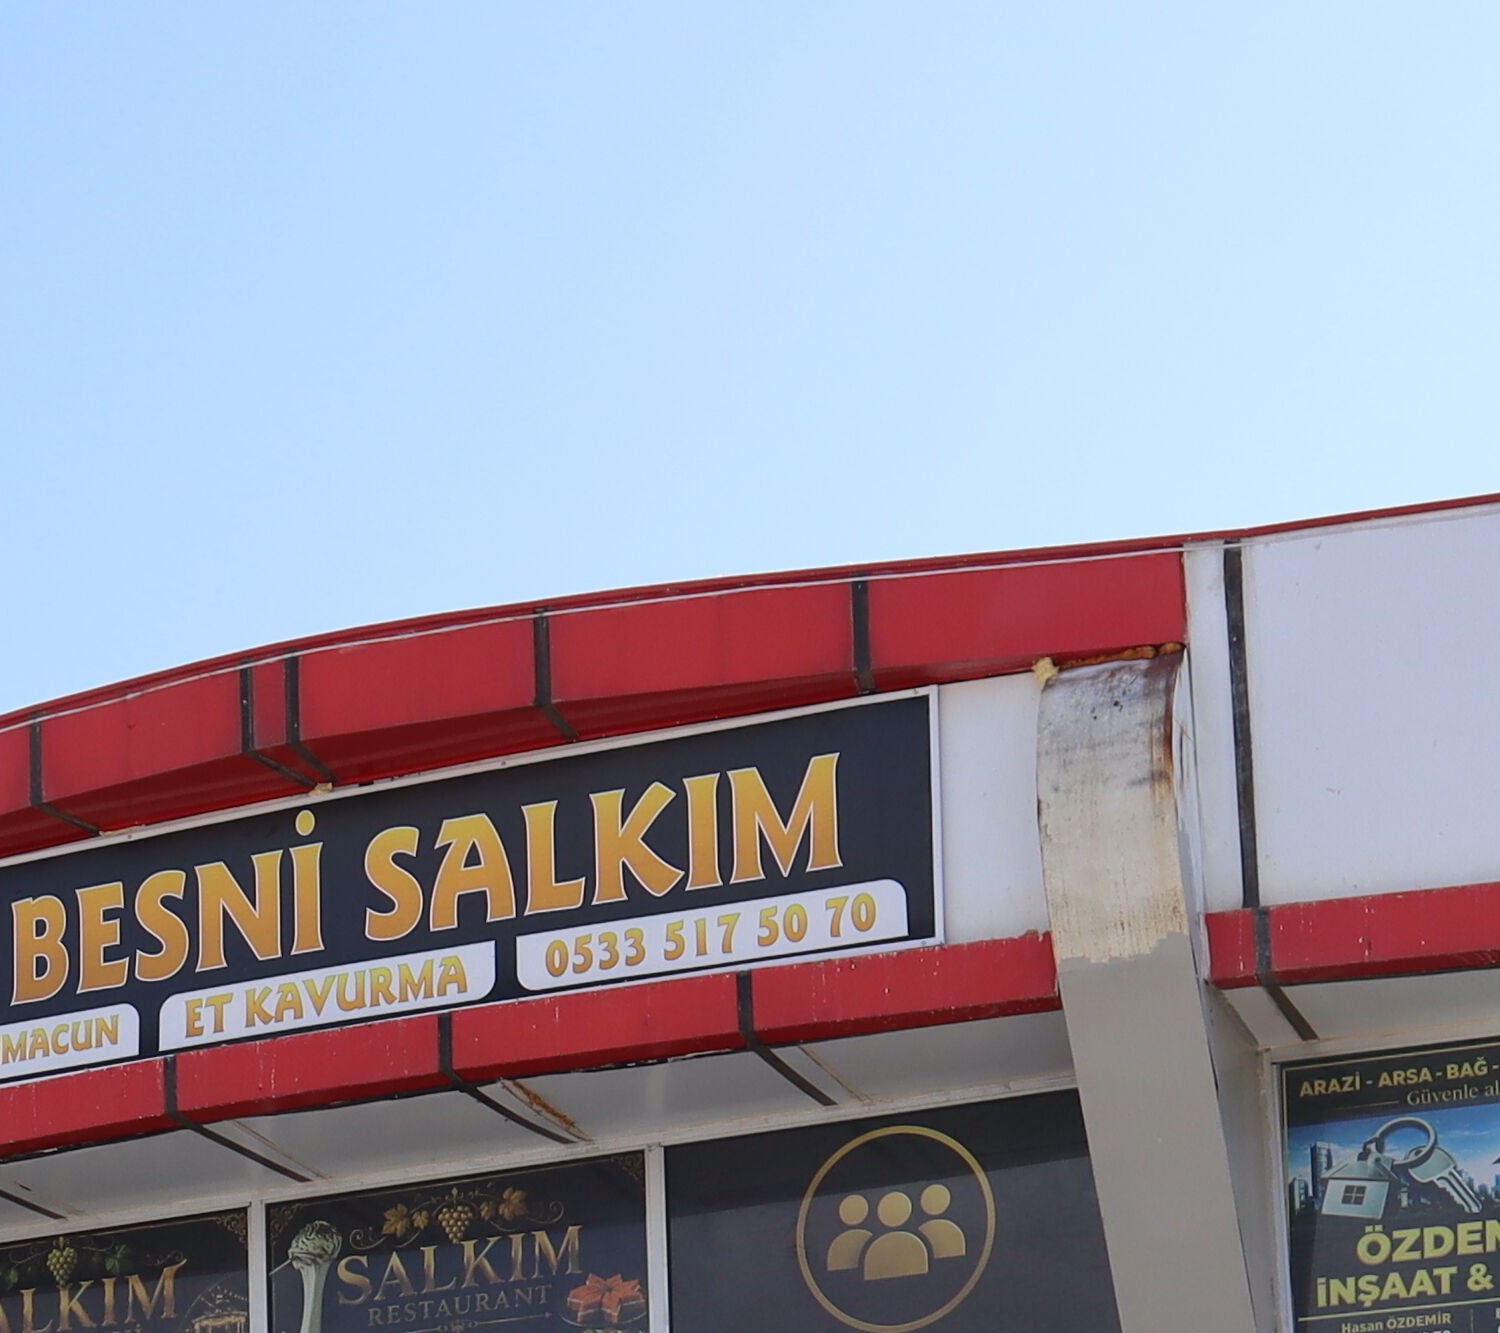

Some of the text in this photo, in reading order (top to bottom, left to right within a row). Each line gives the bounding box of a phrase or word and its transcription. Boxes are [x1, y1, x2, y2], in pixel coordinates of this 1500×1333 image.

[10, 752, 844, 1006] BESNİ SALKIM
[545, 892, 877, 977] 0533 517 50 70
[184, 955, 469, 1039] ET KAVURMA
[1300, 1072, 1360, 1097] ARAZİ
[1378, 1067, 1432, 1088] ARSA
[1447, 1056, 1488, 1080] BAĞ
[1407, 1082, 1479, 1106] Güvenle
[336, 1225, 584, 1305] SALKIM
[1317, 1265, 1458, 1310] İNŞAAT
[1467, 1262, 1494, 1292] &
[367, 1284, 552, 1327] RESTAURANT
[1341, 1312, 1452, 1333] Hasan ÖZDEMİR
